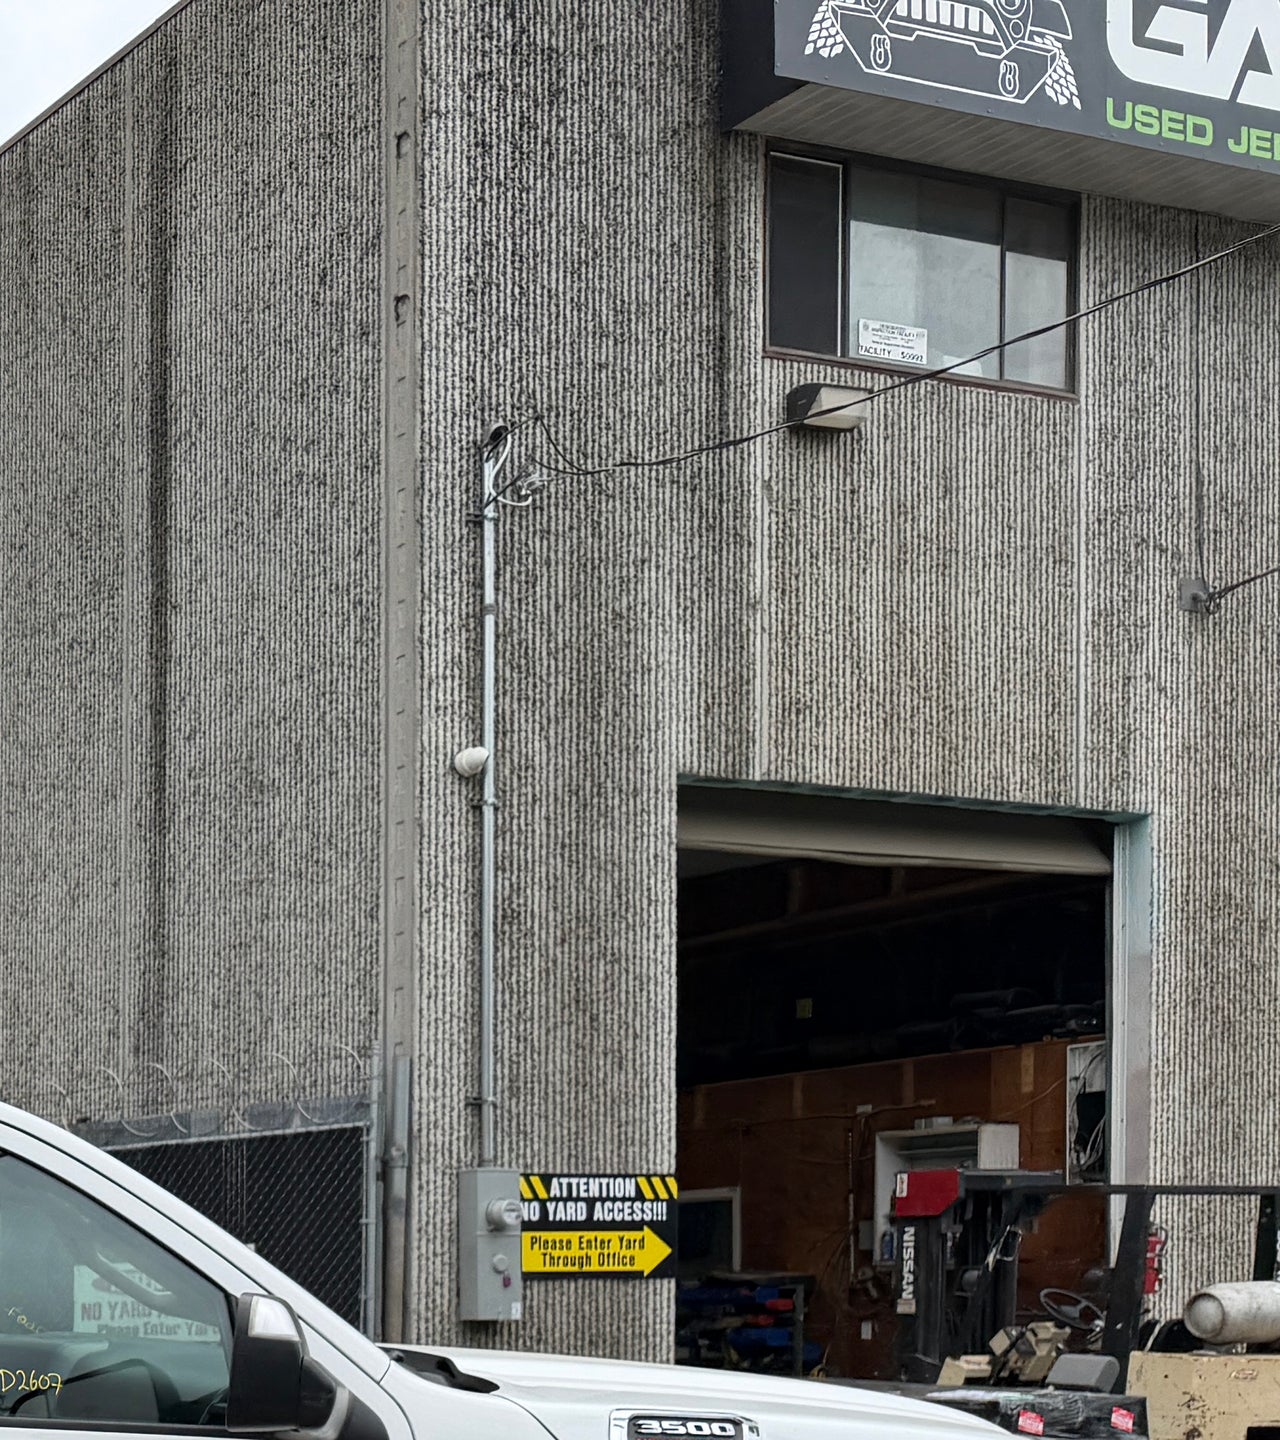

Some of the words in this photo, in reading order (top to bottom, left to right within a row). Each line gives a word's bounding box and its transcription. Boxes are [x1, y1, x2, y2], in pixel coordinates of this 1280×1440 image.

[1107, 97, 1213, 146] USED
[1227, 126, 1280, 160] JE
[550, 1177, 637, 1198] ATTENTION
[521, 1201, 539, 1221] NO
[546, 1201, 587, 1221] YARD
[593, 1201, 667, 1222] ACCESS!!!
[530, 1235, 572, 1251] Please
[578, 1236, 612, 1251] Enter
[618, 1235, 645, 1251] Yard
[541, 1252, 592, 1270] Through
[598, 1252, 635, 1267] Office
[902, 1226, 915, 1299] NISSAN
[0, 1369, 63, 1395] D2607
[635, 1420, 735, 1436] 3500
